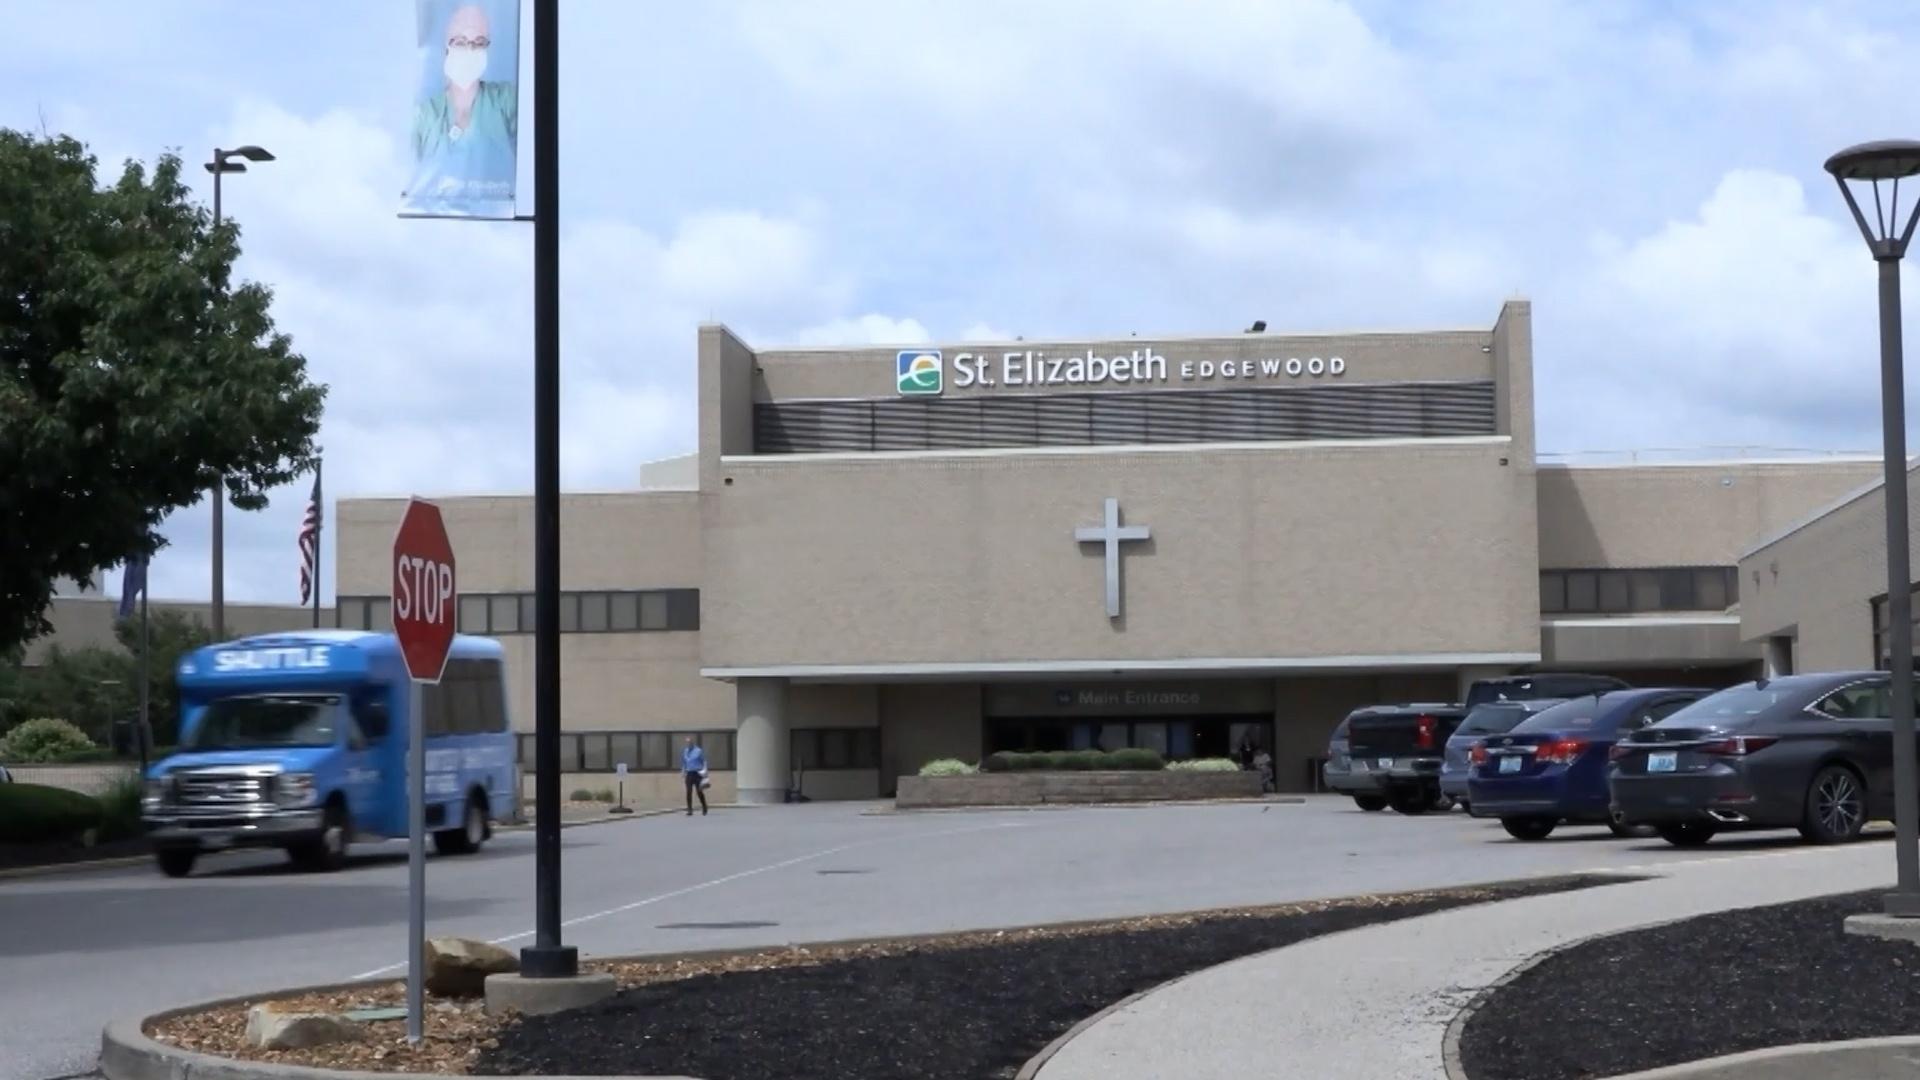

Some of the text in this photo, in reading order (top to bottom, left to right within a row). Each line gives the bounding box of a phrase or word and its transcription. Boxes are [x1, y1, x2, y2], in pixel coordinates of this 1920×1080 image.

[953, 347, 1347, 388] St. Elizabeth EDGEWOOD
[397, 554, 452, 624] STOP
[214, 646, 330, 671] SHUTTLE
[1078, 689, 1201, 705] Main Entrance
